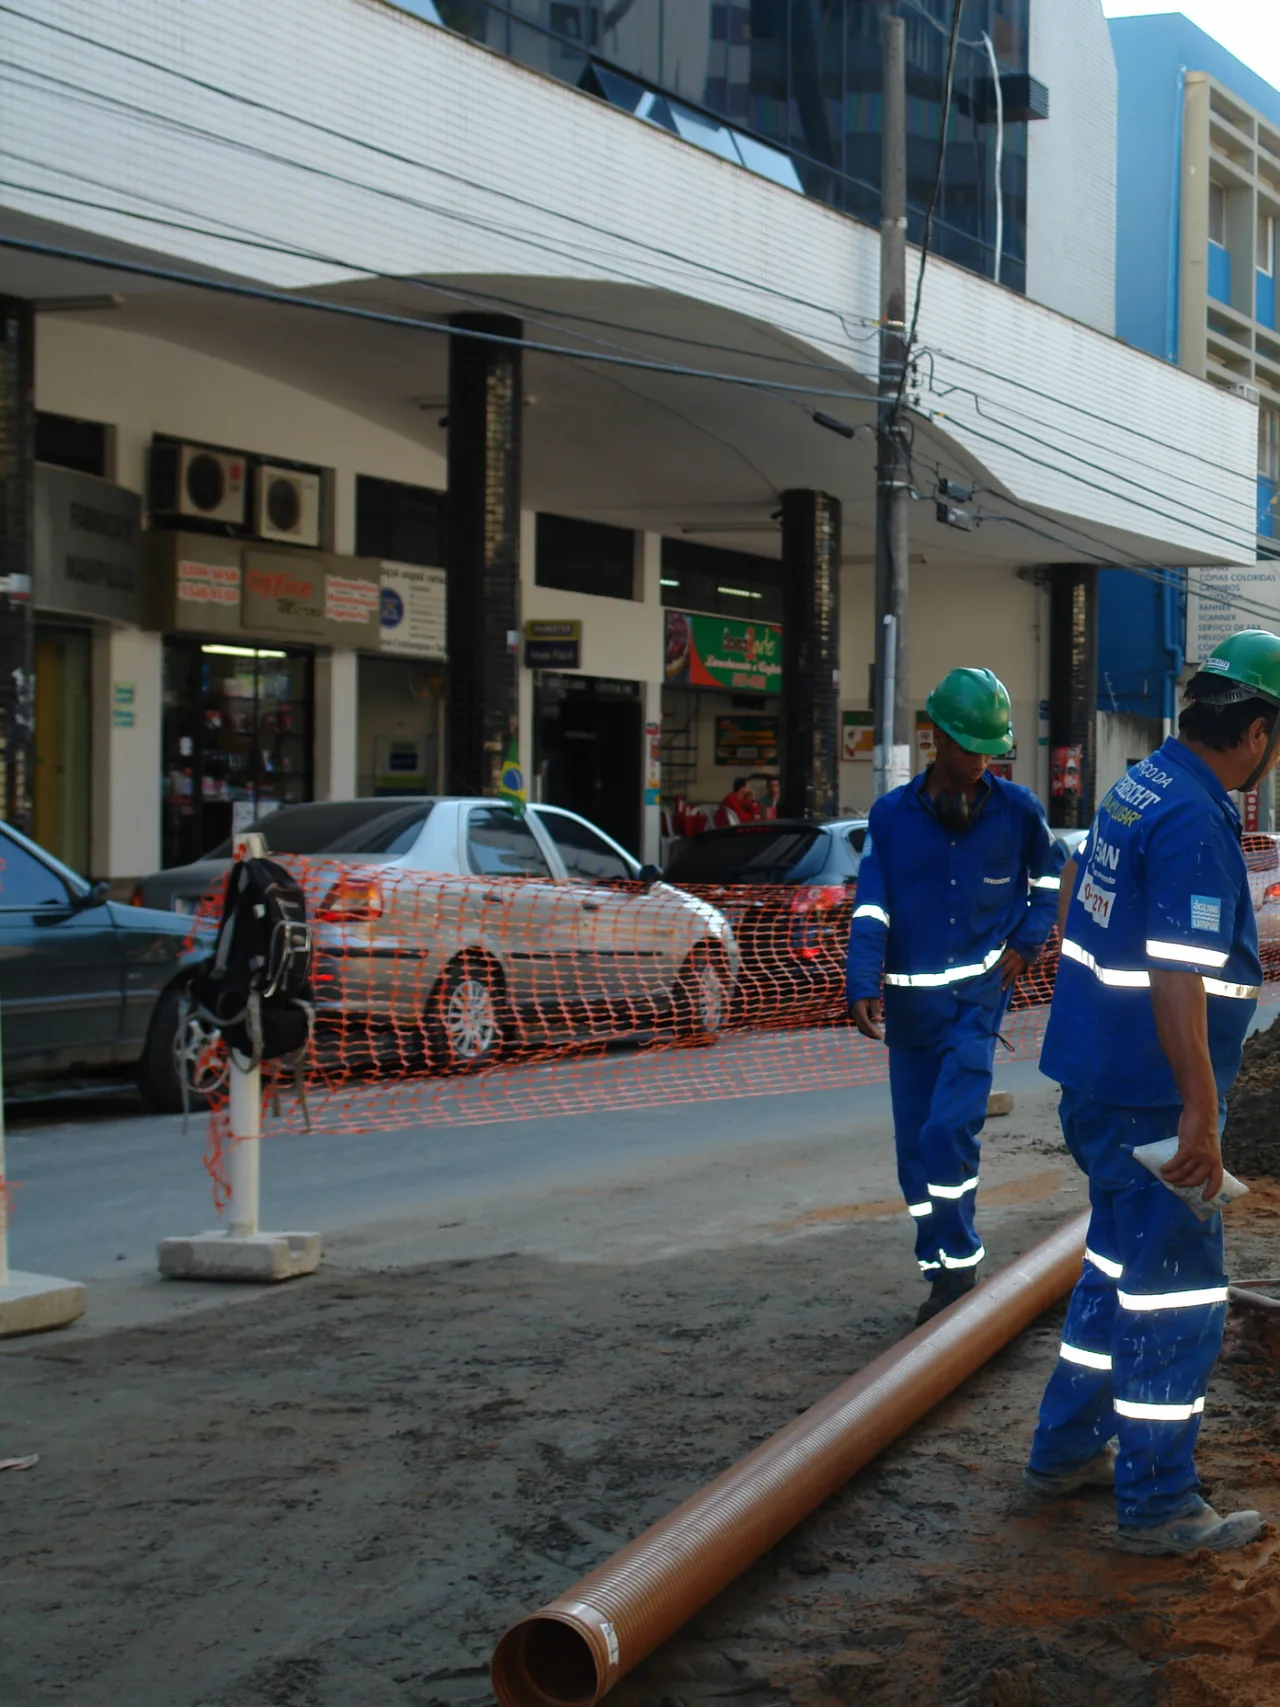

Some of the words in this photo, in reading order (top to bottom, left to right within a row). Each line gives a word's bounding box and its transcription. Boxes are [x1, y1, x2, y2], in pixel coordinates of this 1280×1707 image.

[1231, 574, 1276, 582] COLORIDAS
[1198, 604, 1232, 612] BANNER
[1198, 614, 1237, 622] SCANNER
